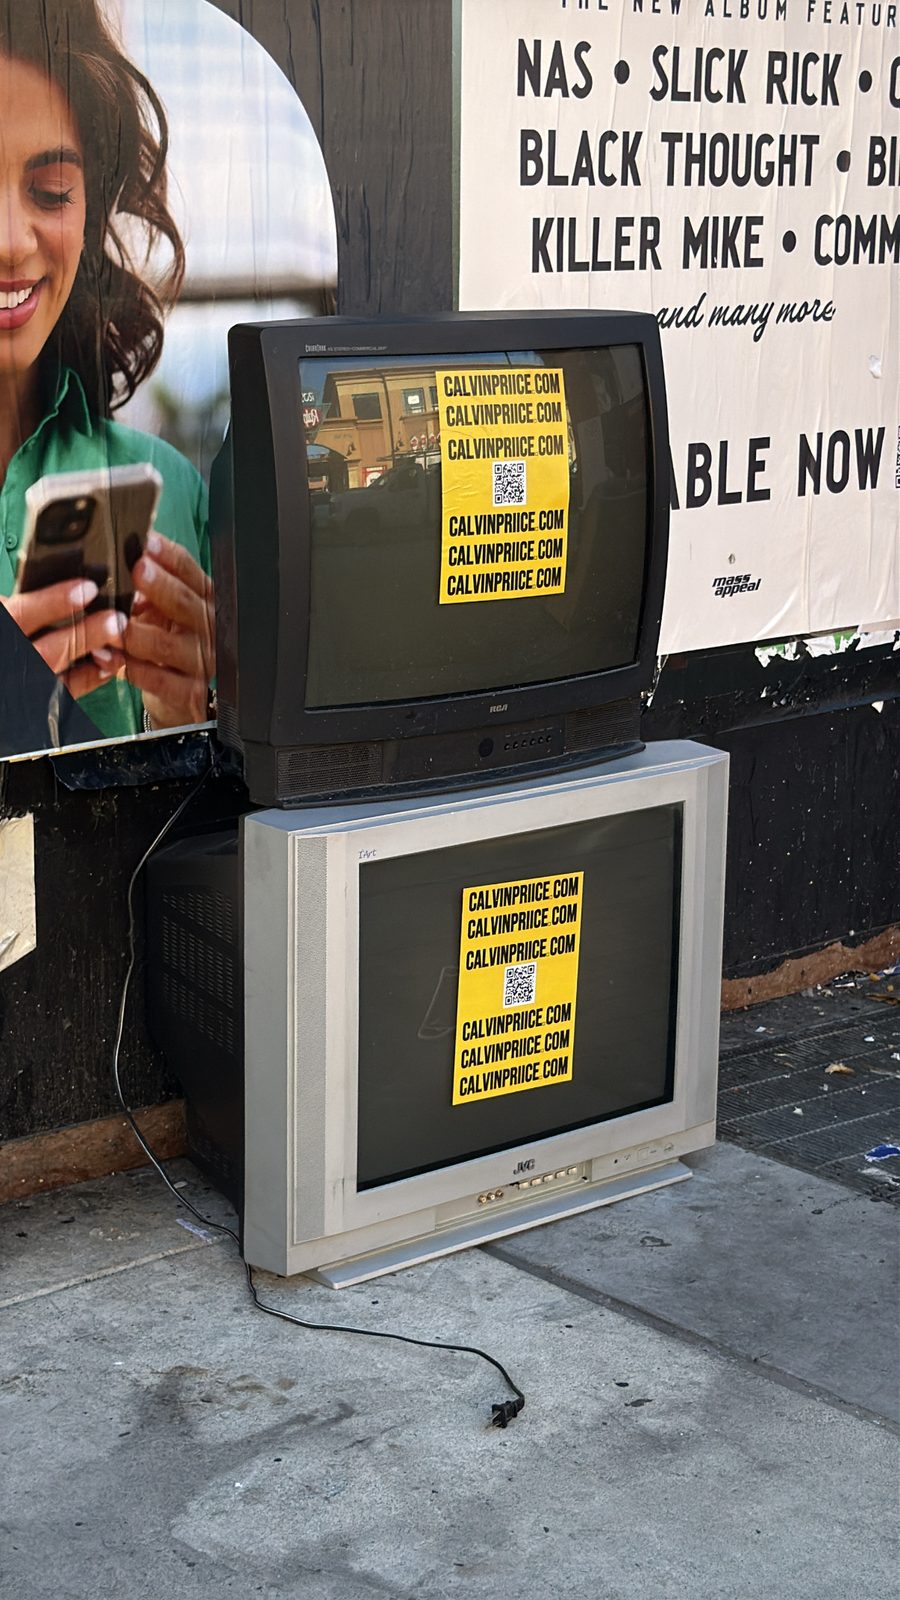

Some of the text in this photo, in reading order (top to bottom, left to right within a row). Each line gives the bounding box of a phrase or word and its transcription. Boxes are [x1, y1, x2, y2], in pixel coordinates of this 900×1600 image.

[704, 0, 787, 21] ALBUM
[807, 0, 897, 28] FEATUR
[517, 38, 593, 99] NAS
[649, 45, 749, 104] SLICK
[766, 50, 843, 106] RICK
[520, 129, 900, 187] BLACK THOUGHT BI
[531, 214, 900, 273] KILLER MIKE COMM
[656, 292, 837, 343] and many more
[797, 426, 886, 497] NOW
[712, 573, 752, 588] mass
[714, 578, 762, 598] appeal
[489, 703, 509, 713] RCA
[513, 1158, 536, 1175] JVC
